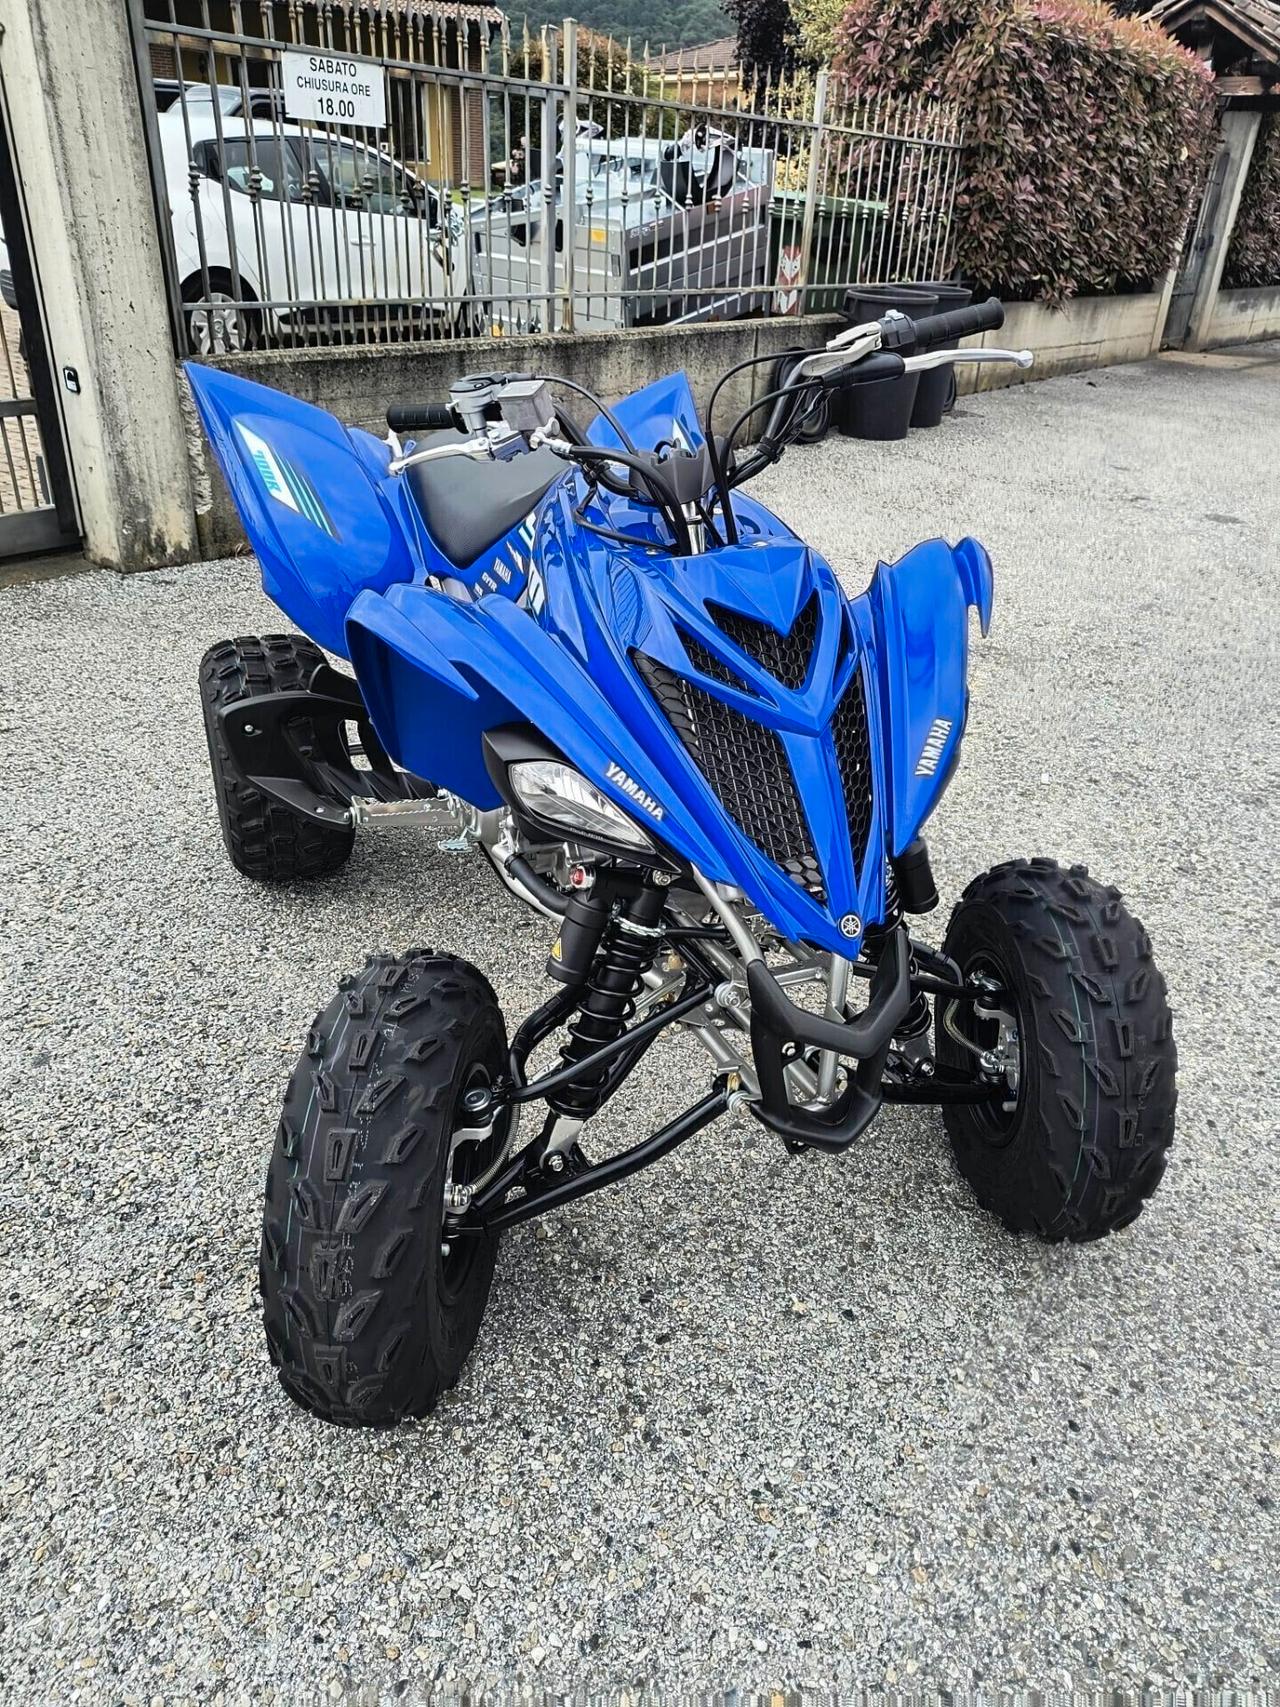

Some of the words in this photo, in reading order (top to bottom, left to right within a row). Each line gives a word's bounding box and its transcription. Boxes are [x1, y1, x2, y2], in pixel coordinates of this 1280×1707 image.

[309, 57, 357, 77] SABATO
[296, 75, 349, 94] CHIUSURA
[351, 83, 371, 97] ORE
[317, 97, 355, 118] 18.00
[481, 571, 498, 593] GYTR
[914, 718, 953, 776] YAMAHA
[605, 761, 664, 821] YAMAHA
